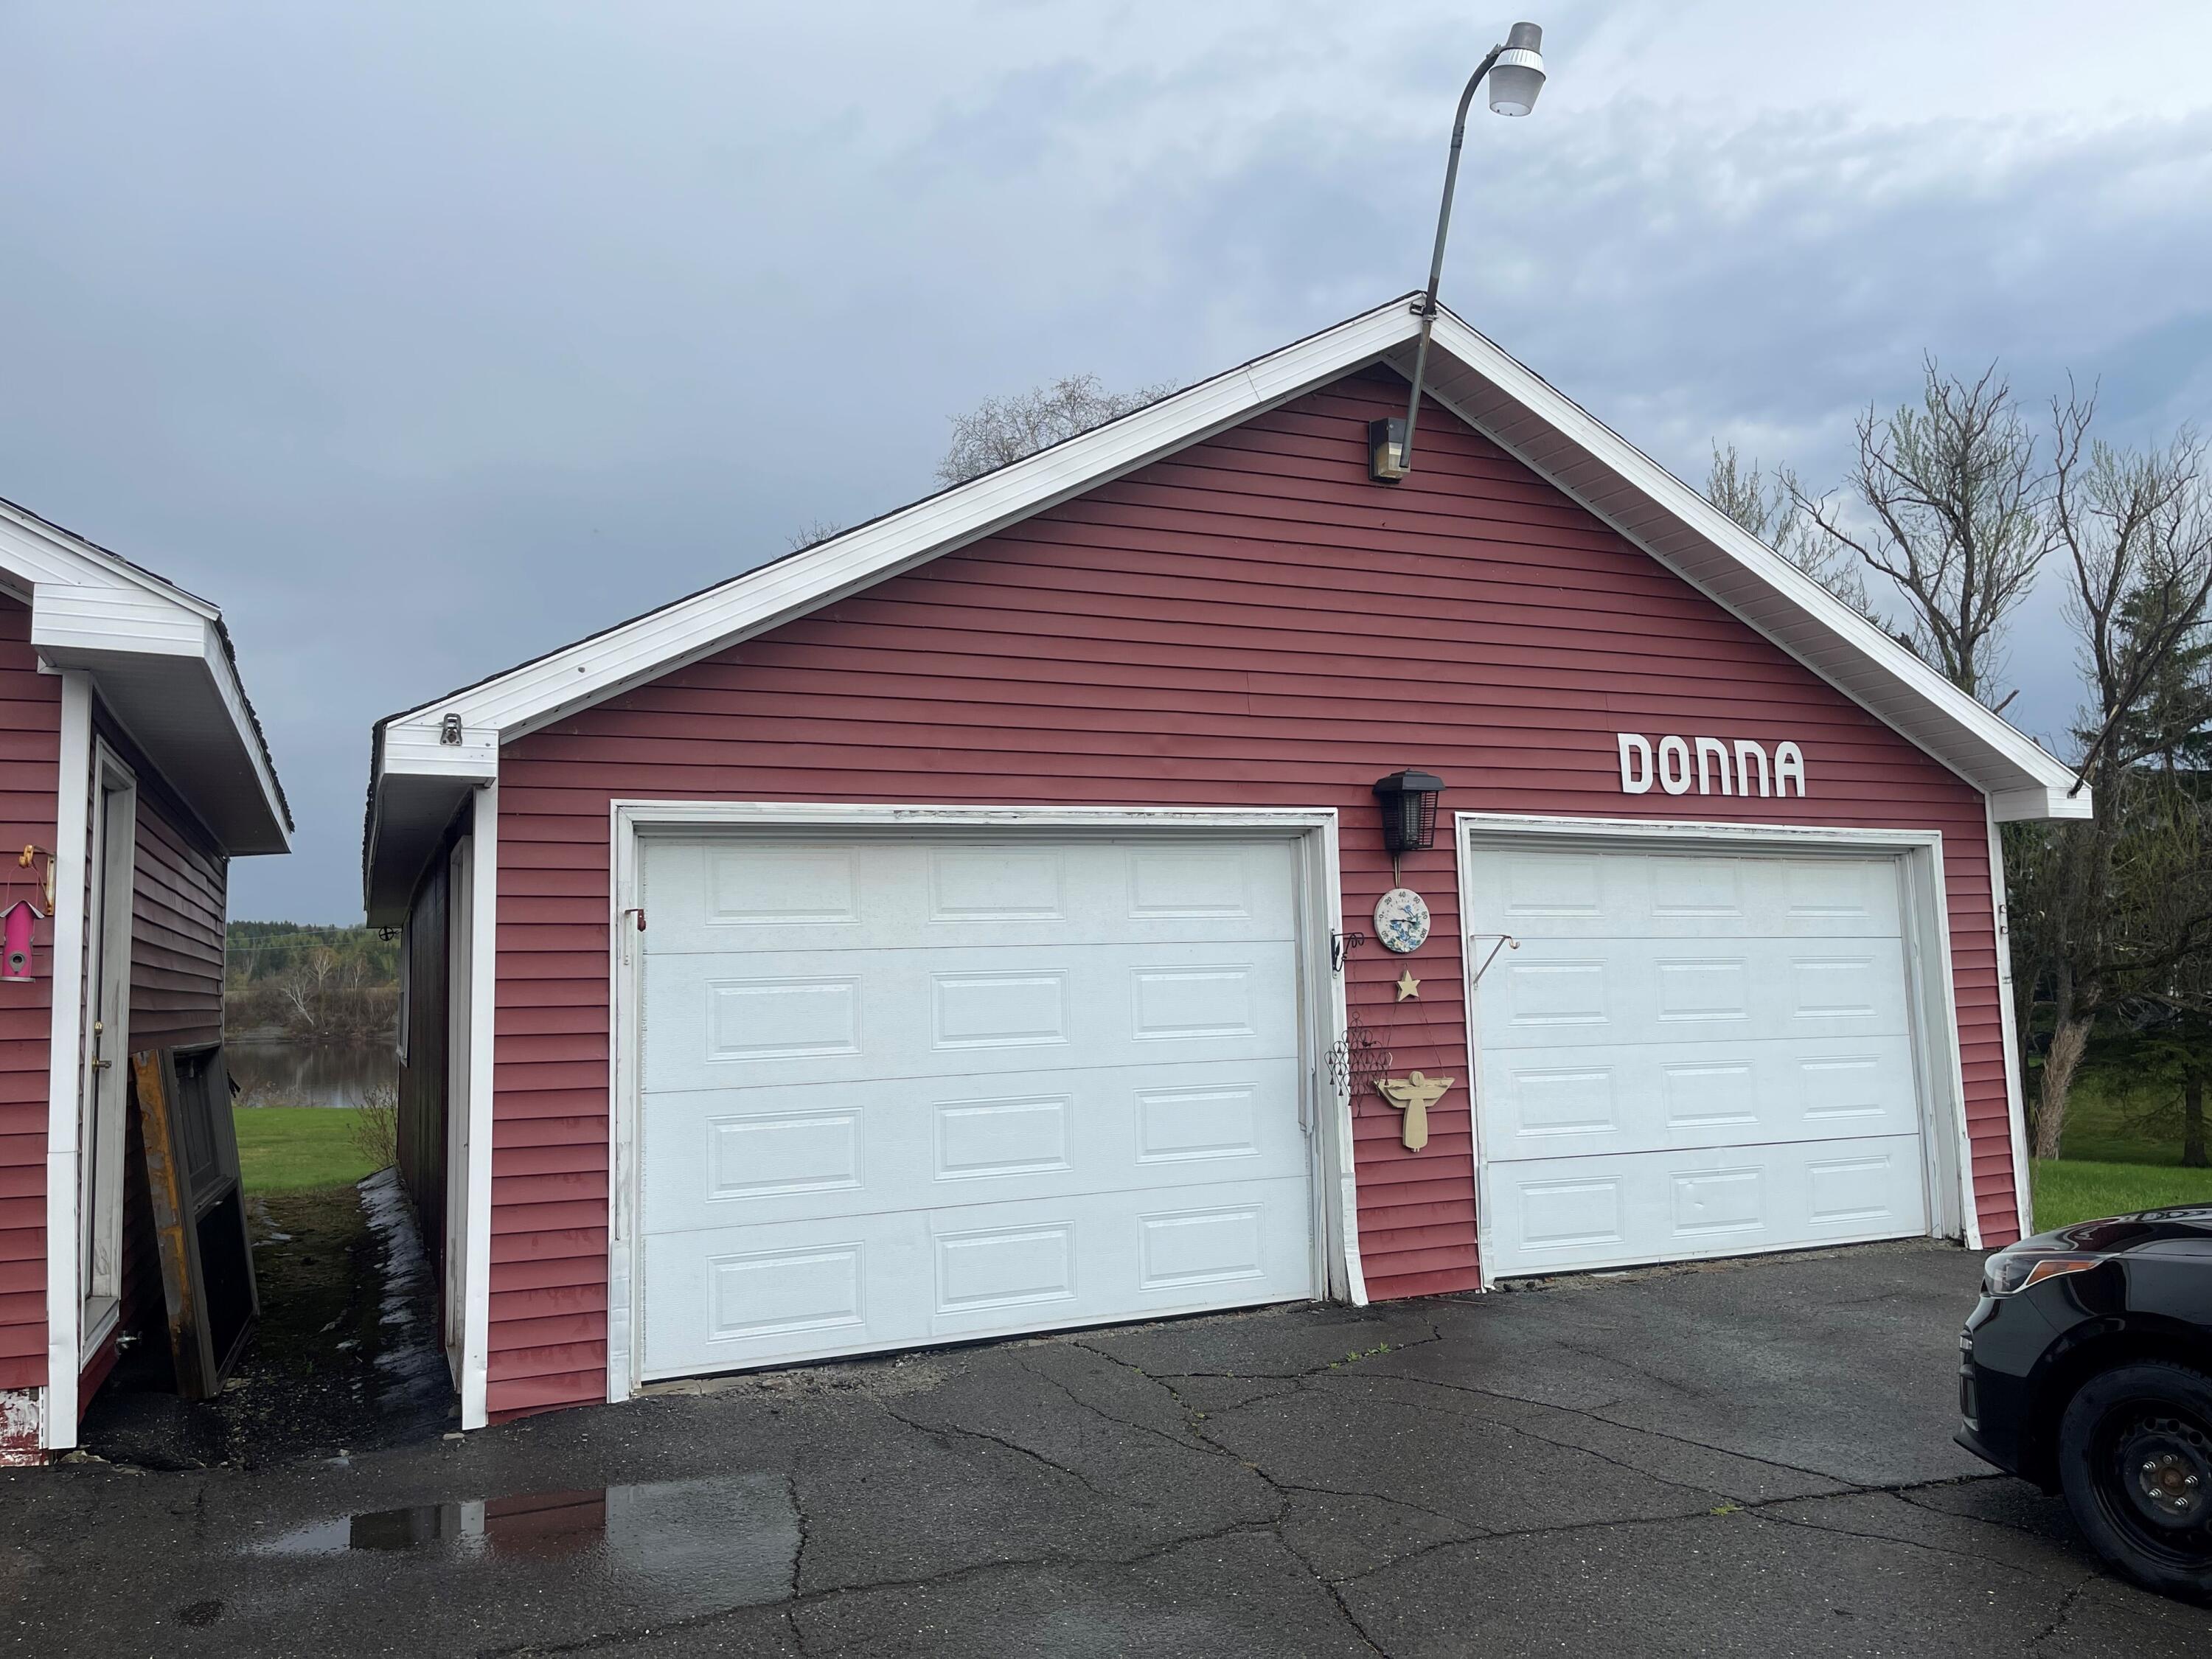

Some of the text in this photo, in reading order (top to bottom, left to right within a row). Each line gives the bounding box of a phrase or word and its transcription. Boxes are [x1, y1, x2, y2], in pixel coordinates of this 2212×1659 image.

[1618, 733, 1805, 797] DONNA
[1384, 897, 1392, 905] 20
[1422, 911, 1427, 919] 80
